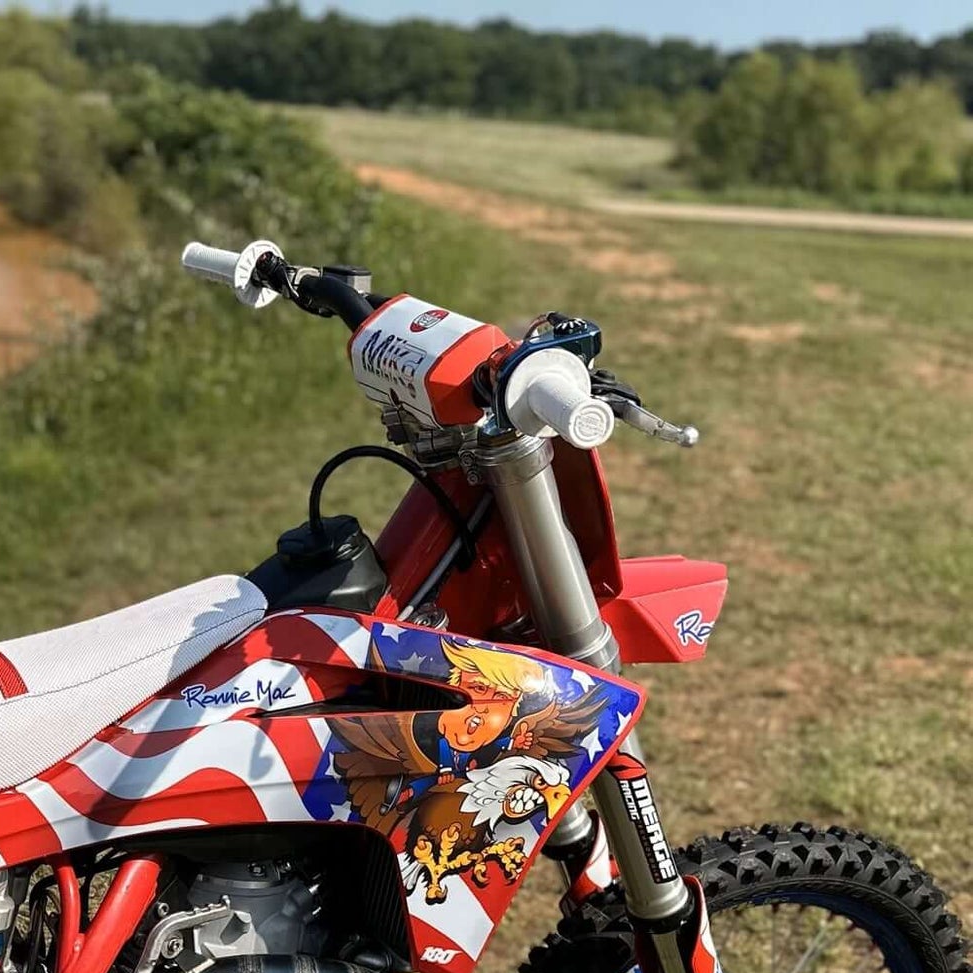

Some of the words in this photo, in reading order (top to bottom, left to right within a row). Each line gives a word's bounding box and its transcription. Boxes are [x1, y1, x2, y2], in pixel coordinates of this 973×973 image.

[182, 685, 254, 708] Ronnie
[256, 680, 296, 706] Mac
[619, 780, 640, 821] RACING
[630, 777, 677, 880] MERGE
